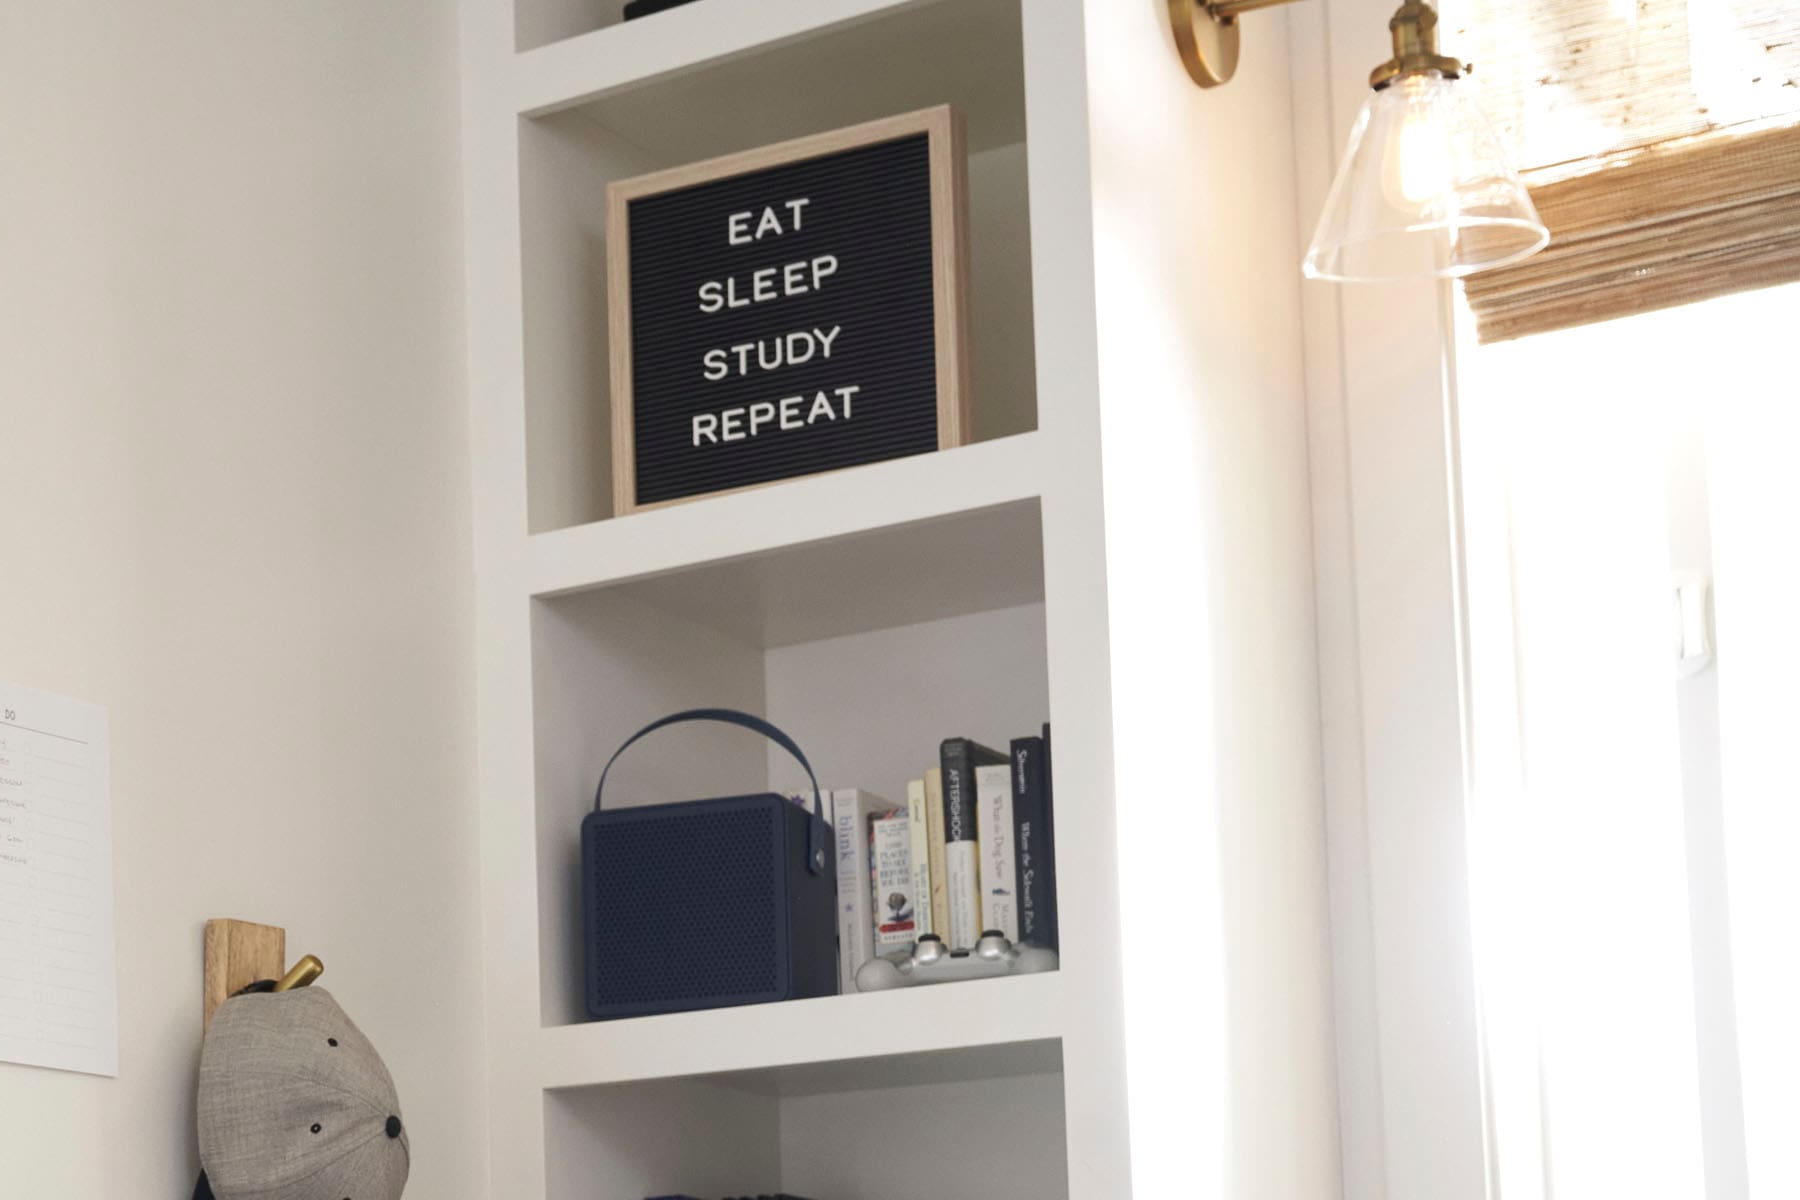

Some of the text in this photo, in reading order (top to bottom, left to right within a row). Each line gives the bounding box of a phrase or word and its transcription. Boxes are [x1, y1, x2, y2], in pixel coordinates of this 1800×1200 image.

[728, 198, 810, 245] EAT
[698, 255, 838, 312] SLEEP
[703, 325, 841, 380] STUDY
[692, 385, 860, 447] REPEAT
[4, 708, 16, 721] DO
[839, 815, 855, 861] blink
